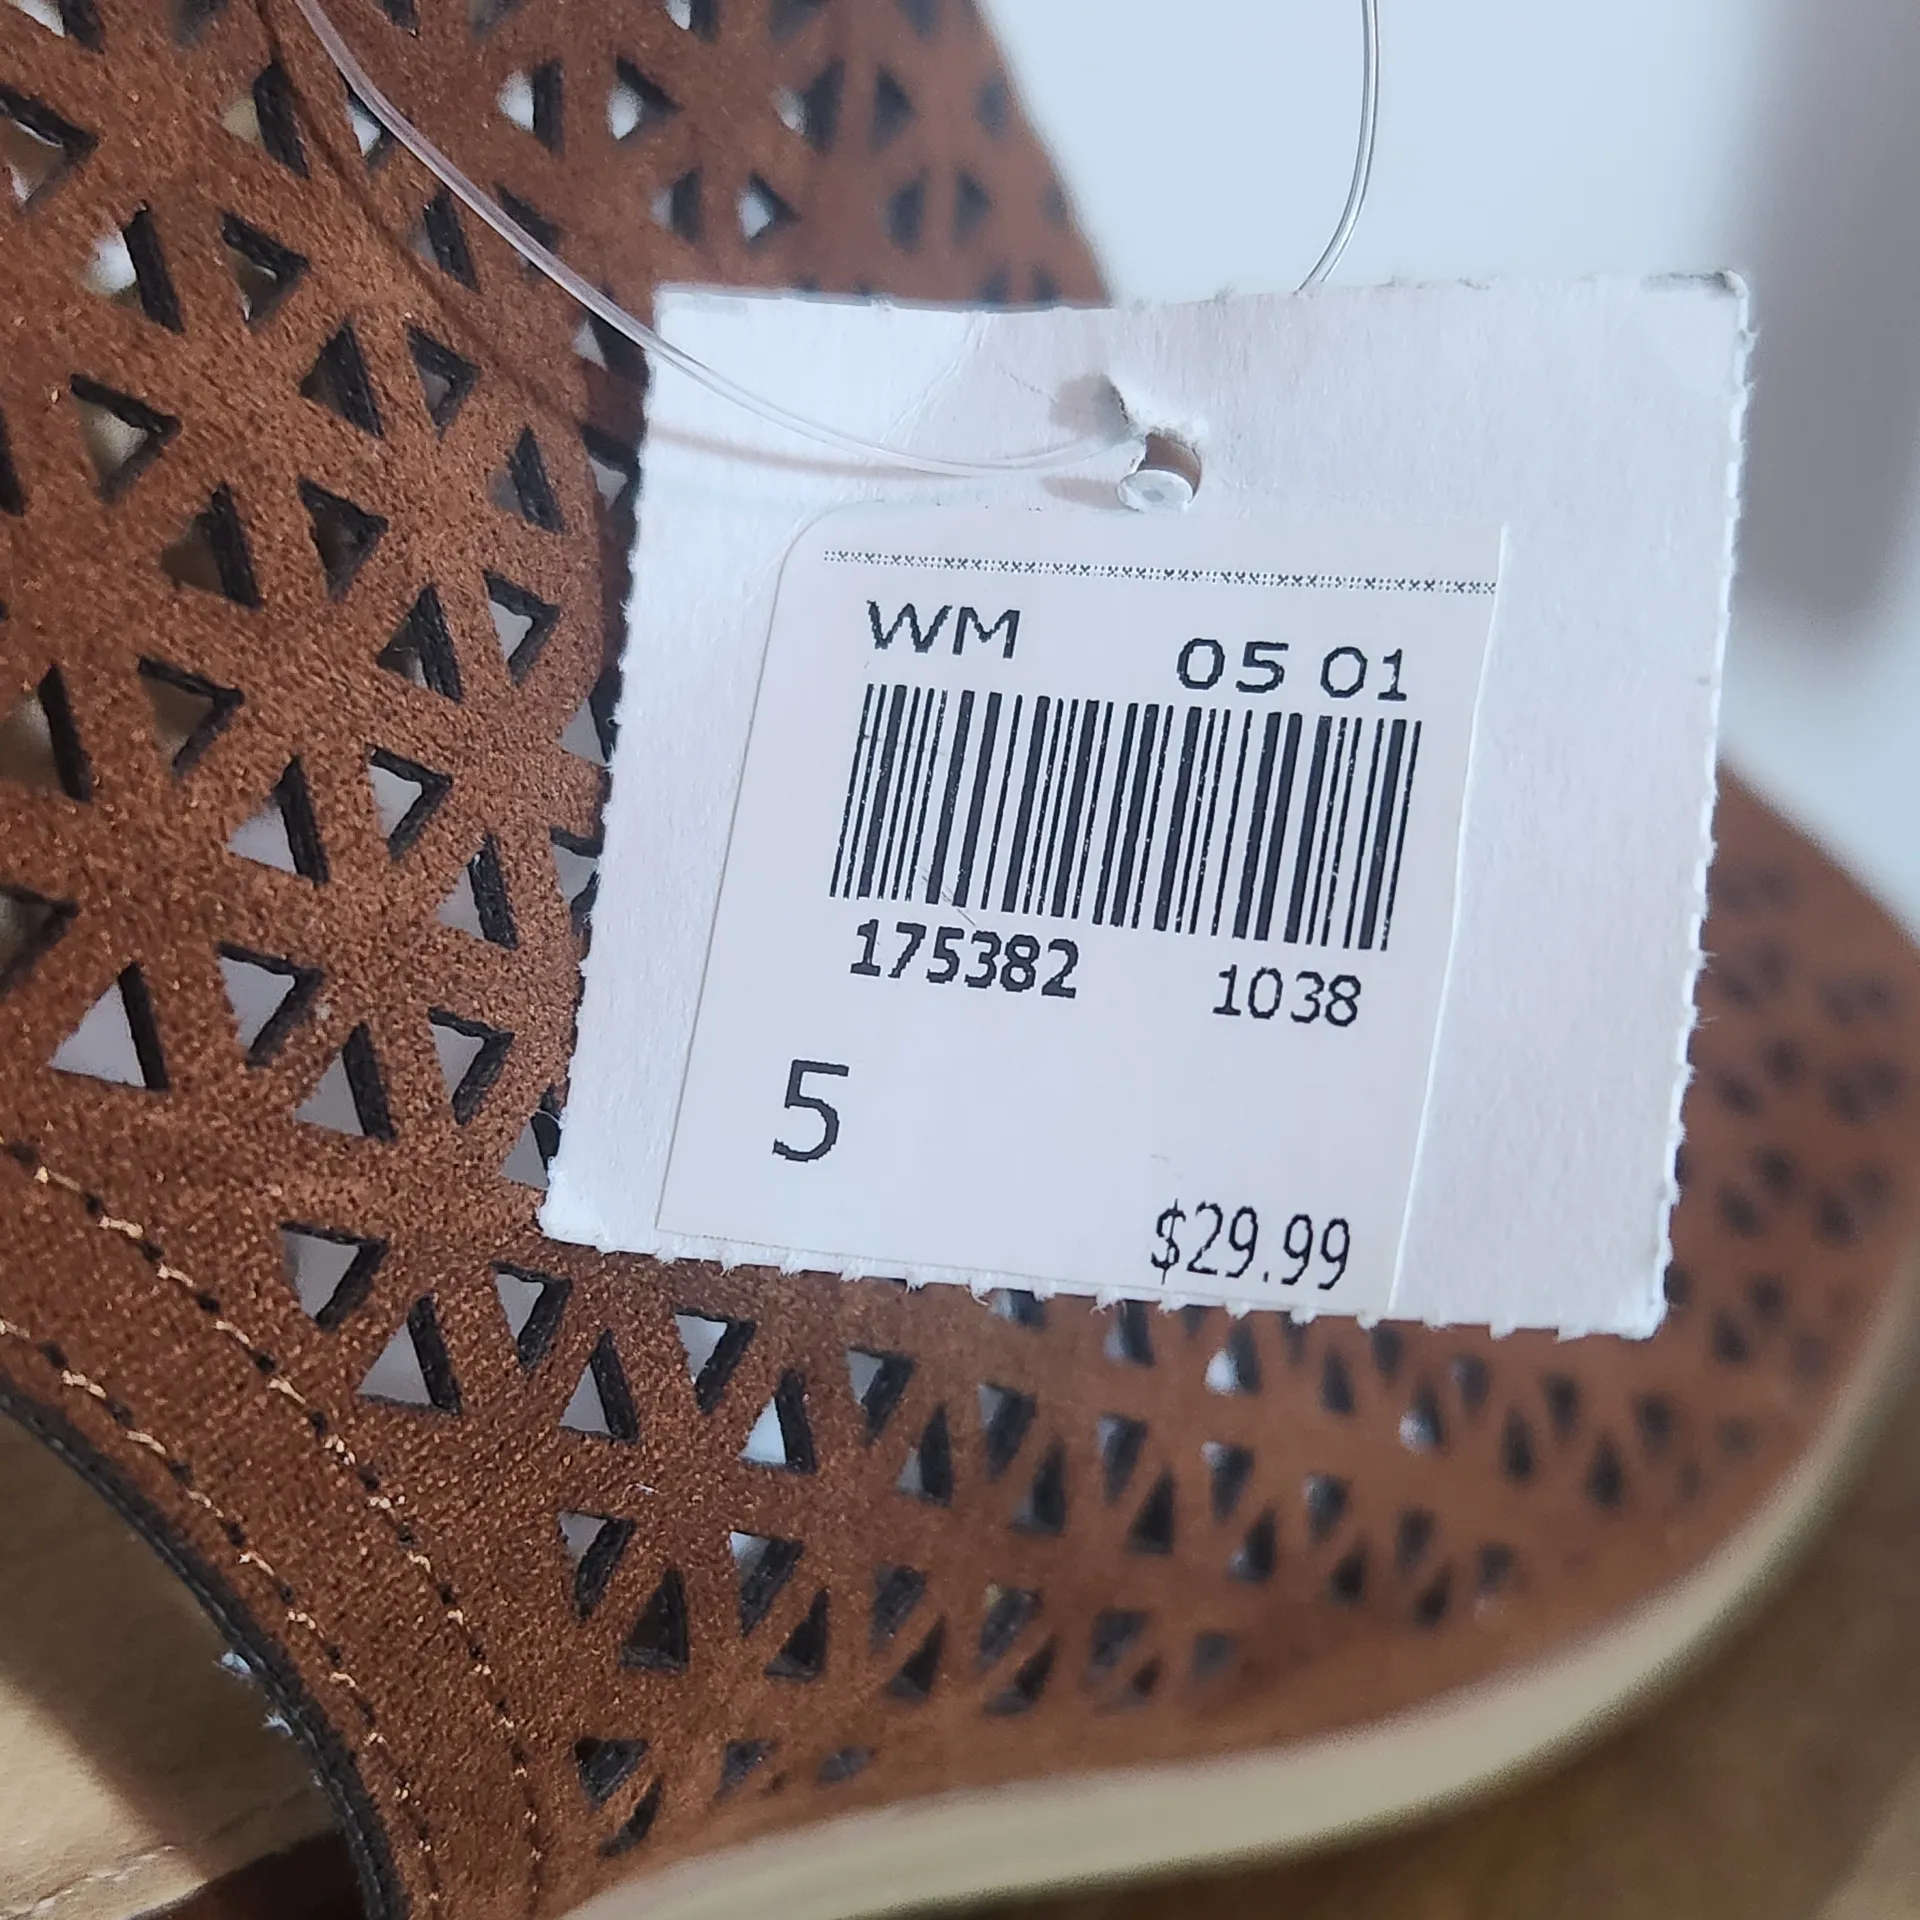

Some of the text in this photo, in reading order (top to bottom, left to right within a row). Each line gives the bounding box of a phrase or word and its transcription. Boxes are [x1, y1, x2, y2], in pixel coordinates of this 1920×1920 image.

[867, 600, 1407, 702] WM 05 01
[850, 918, 1362, 1028] 175382 1038
[772, 1059, 850, 1163] 5
[1150, 1199, 1351, 1291] $29.99
